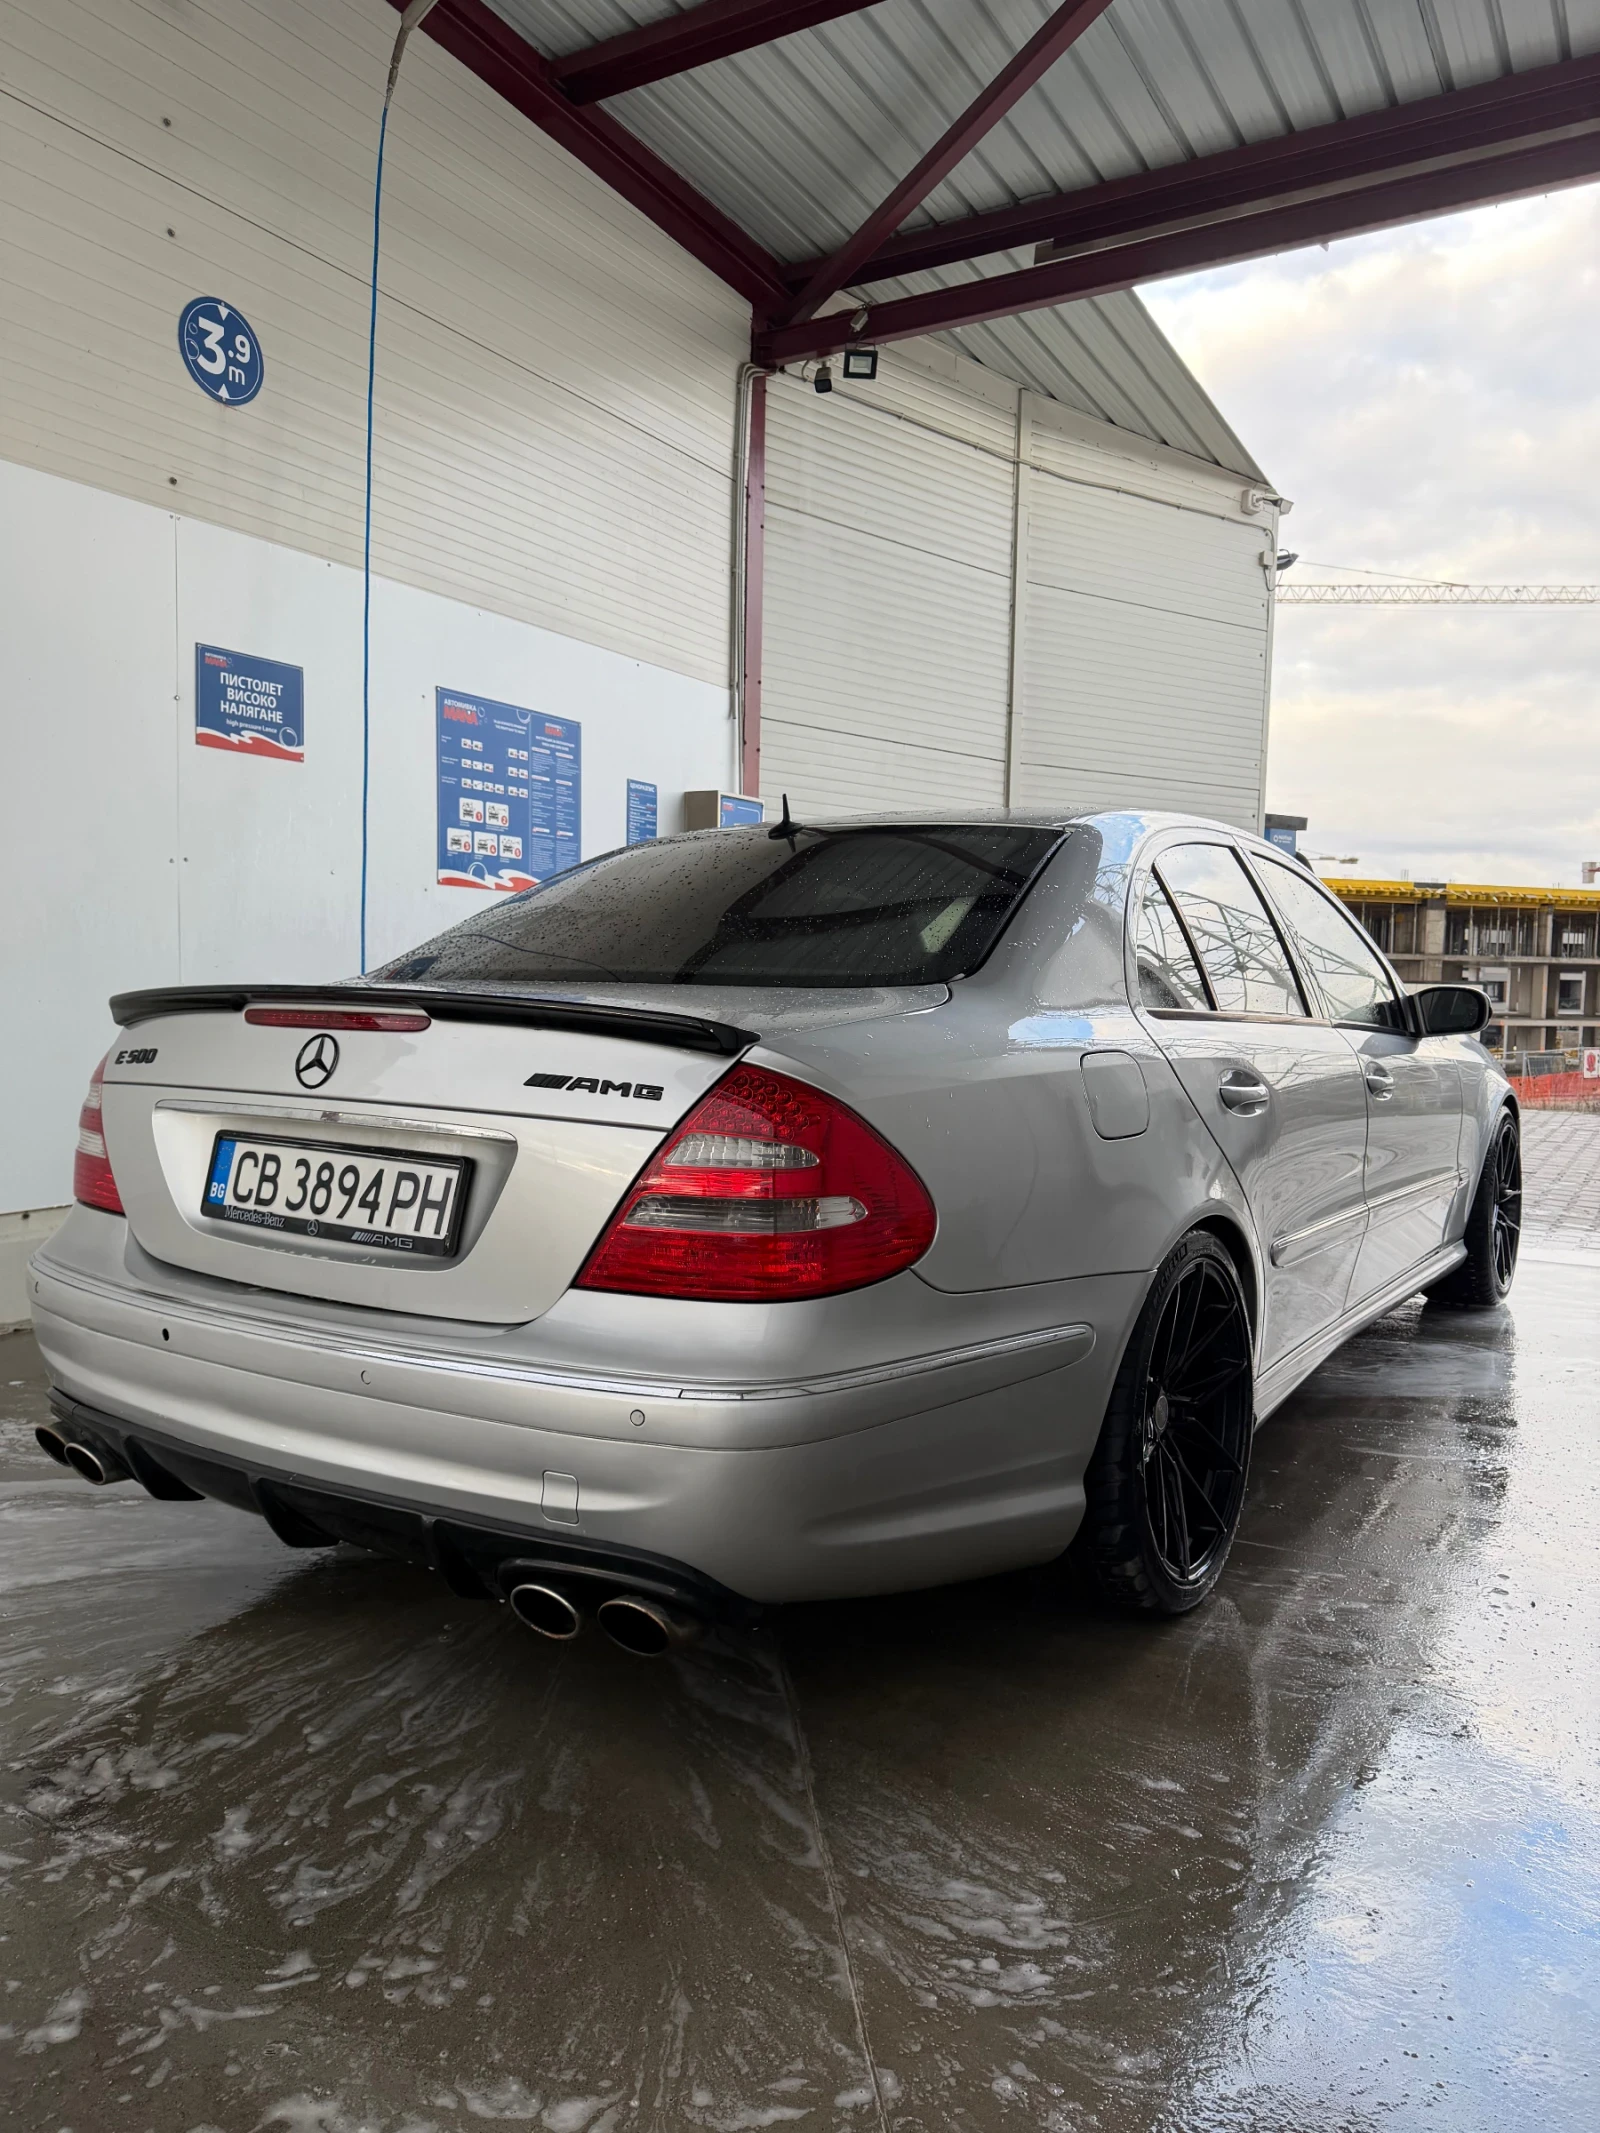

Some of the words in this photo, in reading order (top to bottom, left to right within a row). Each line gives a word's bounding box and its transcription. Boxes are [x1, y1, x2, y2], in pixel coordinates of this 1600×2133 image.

[197, 316, 251, 375] 3.9
[228, 365, 246, 386] m
[220, 671, 284, 697] ПИСТОЛЕТ
[227, 687, 277, 709] ВИСОКО
[220, 700, 283, 724] НАЛЯГАНЕ
[225, 718, 239, 728] high
[239, 721, 262, 731] pressure
[115, 1050, 128, 1065] E
[126, 1048, 158, 1064] 500
[566, 1076, 664, 1101] AMG
[210, 1182, 225, 1199] BG
[232, 1151, 282, 1207] CB
[285, 1158, 385, 1224] 3894
[385, 1171, 453, 1235] PH
[224, 1204, 285, 1228] Mercedes-Benz
[371, 1234, 414, 1249] AMG
